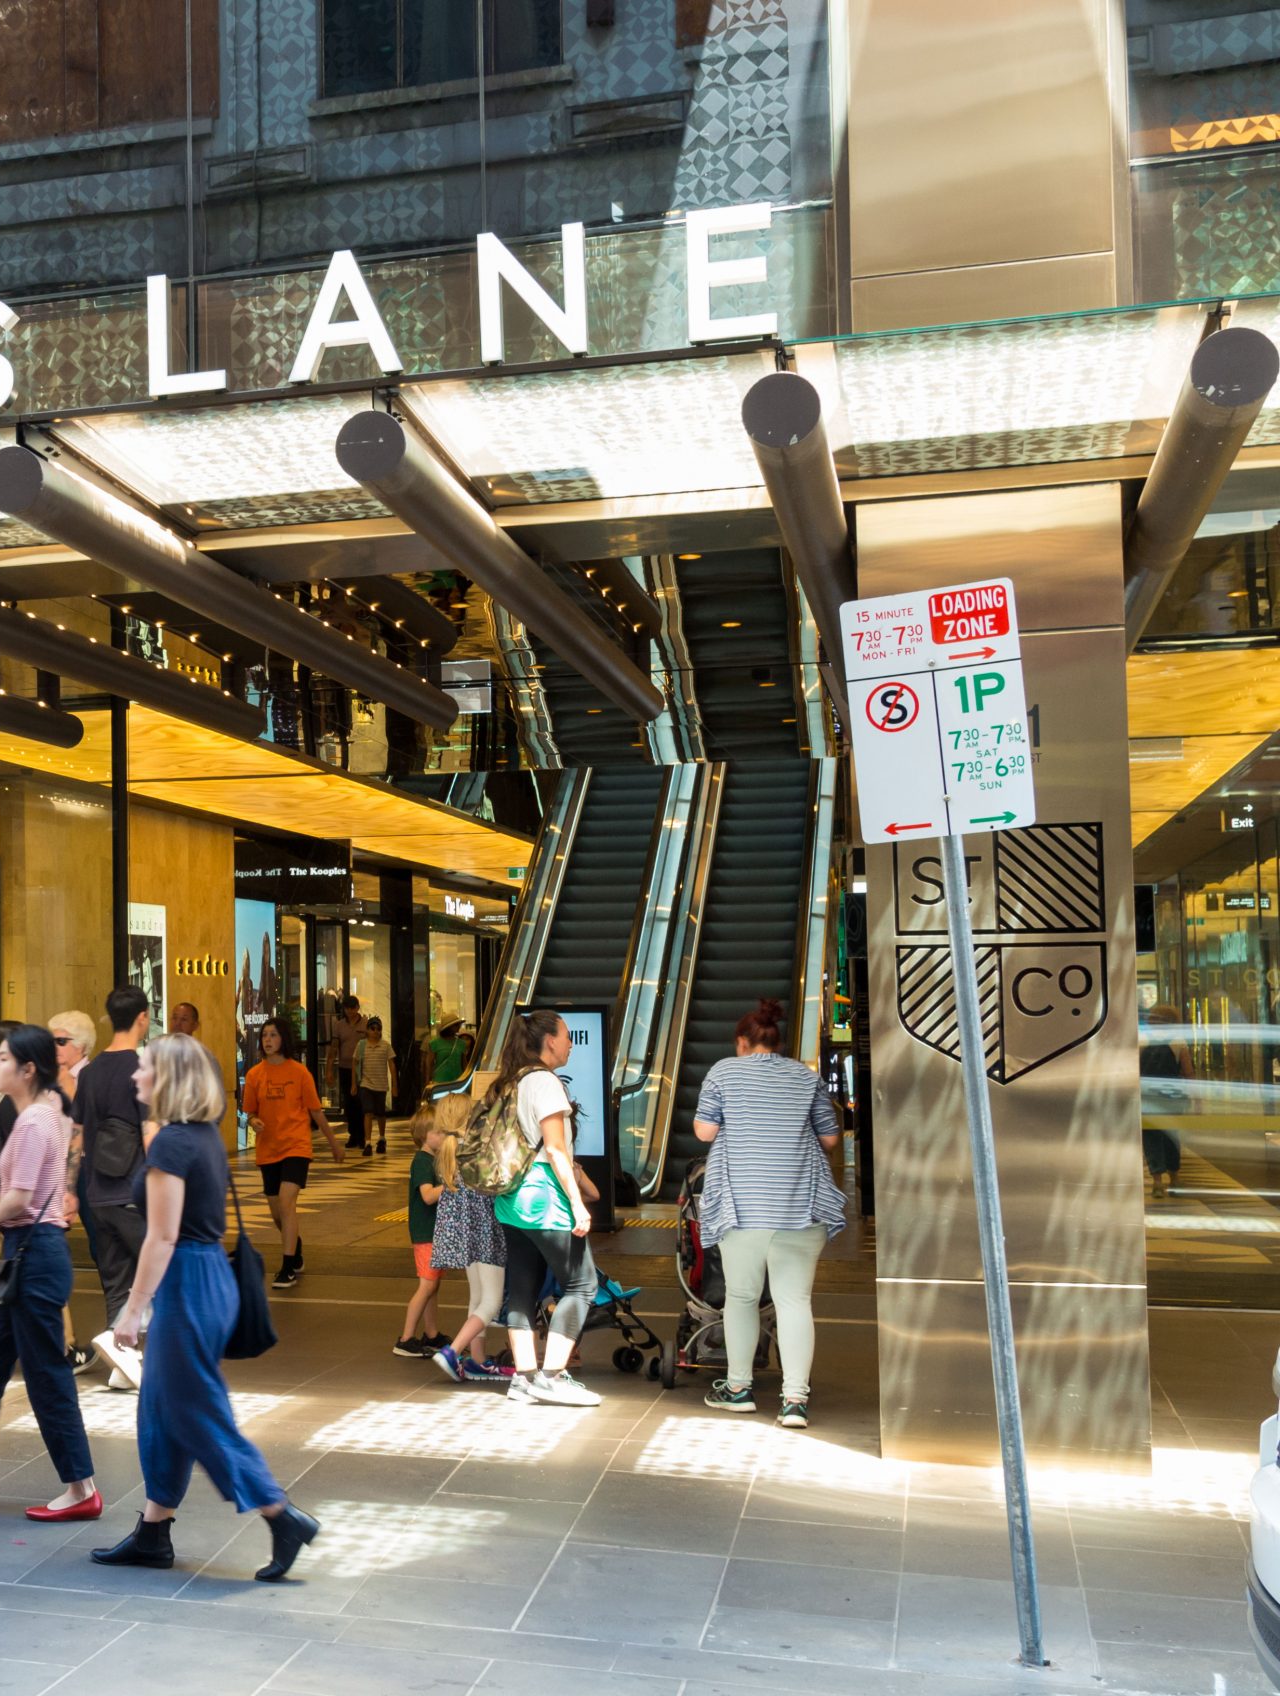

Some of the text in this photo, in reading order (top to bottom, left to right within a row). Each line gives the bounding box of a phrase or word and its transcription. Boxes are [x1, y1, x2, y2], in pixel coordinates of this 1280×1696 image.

[146, 202, 778, 398] LANE
[931, 587, 1004, 617] LOADING
[856, 607, 914, 623] 15 MINUTE
[943, 614, 998, 641] ZONE
[862, 651, 888, 661] MON
[897, 647, 916, 657] FRI
[954, 671, 1005, 713] 1P
[976, 748, 999, 758] SAT
[979, 780, 1003, 790] SUN
[1231, 818, 1254, 828] Exit
[289, 867, 347, 877] The Kooples
[175, 953, 229, 977] sandro
